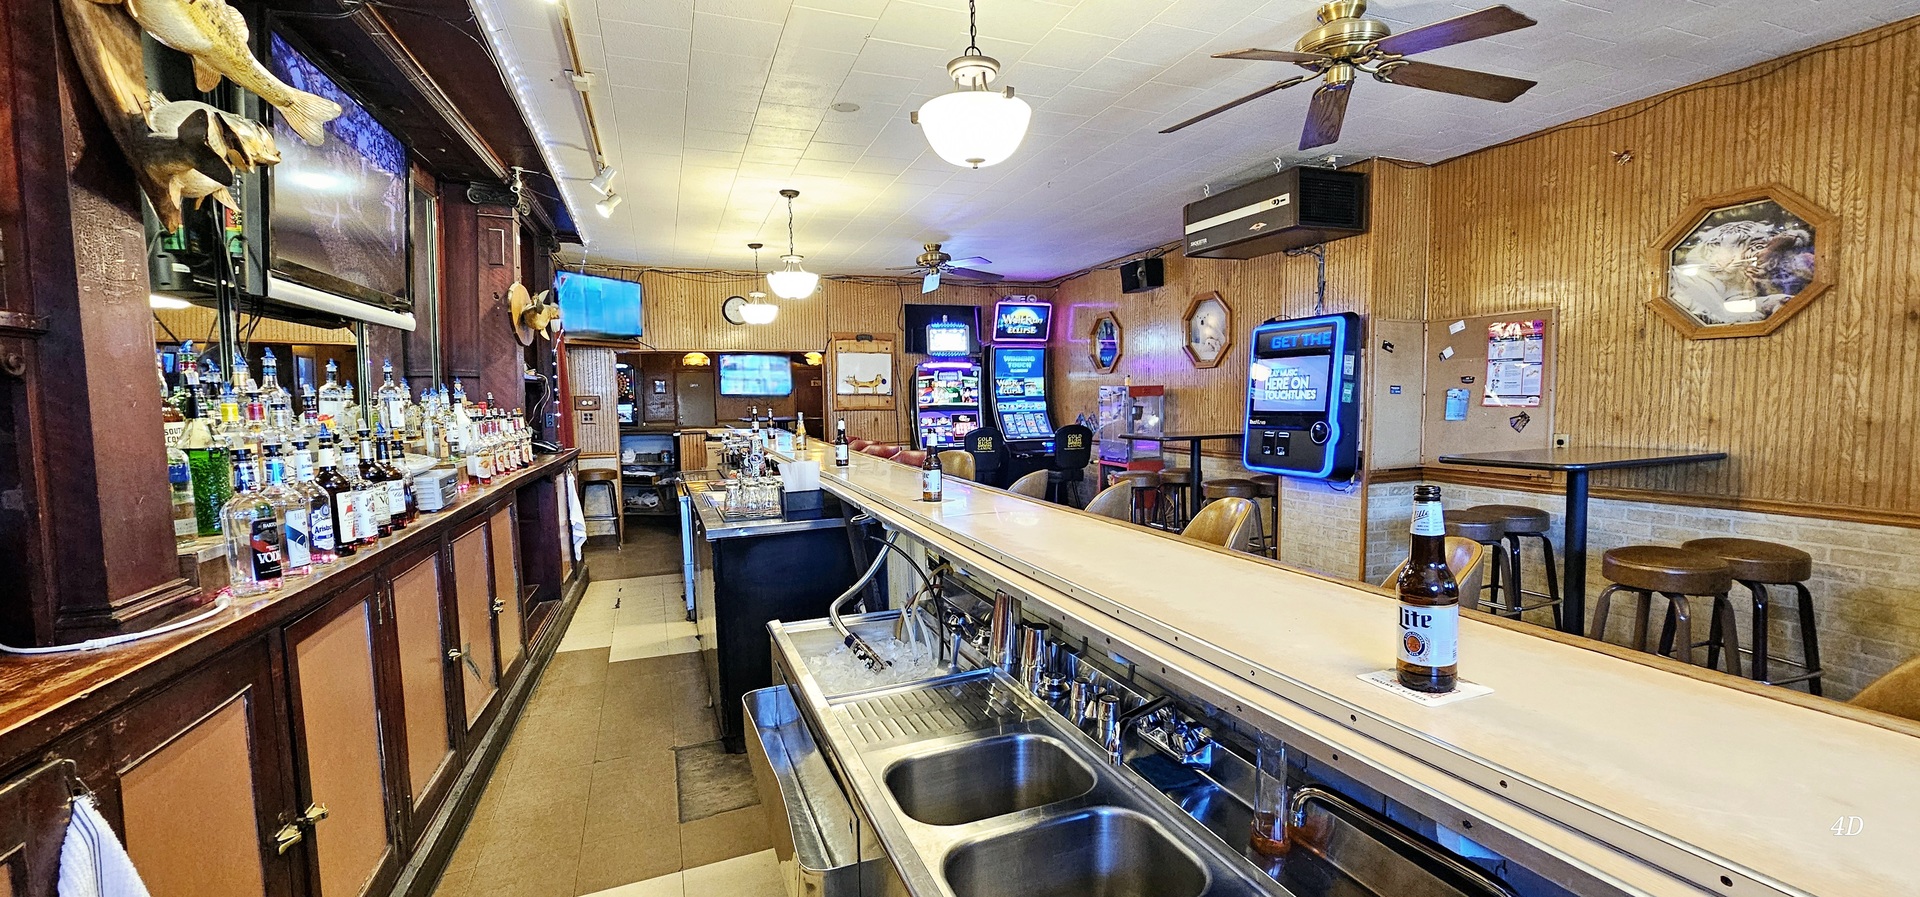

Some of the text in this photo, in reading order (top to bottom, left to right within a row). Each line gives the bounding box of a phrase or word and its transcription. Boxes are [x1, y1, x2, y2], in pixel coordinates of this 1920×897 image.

[1271, 331, 1332, 349] GET THE
[1265, 375, 1310, 390] HERE ON
[1265, 389, 1317, 400] TOUCHTUNES
[1398, 606, 1433, 630] Lite
